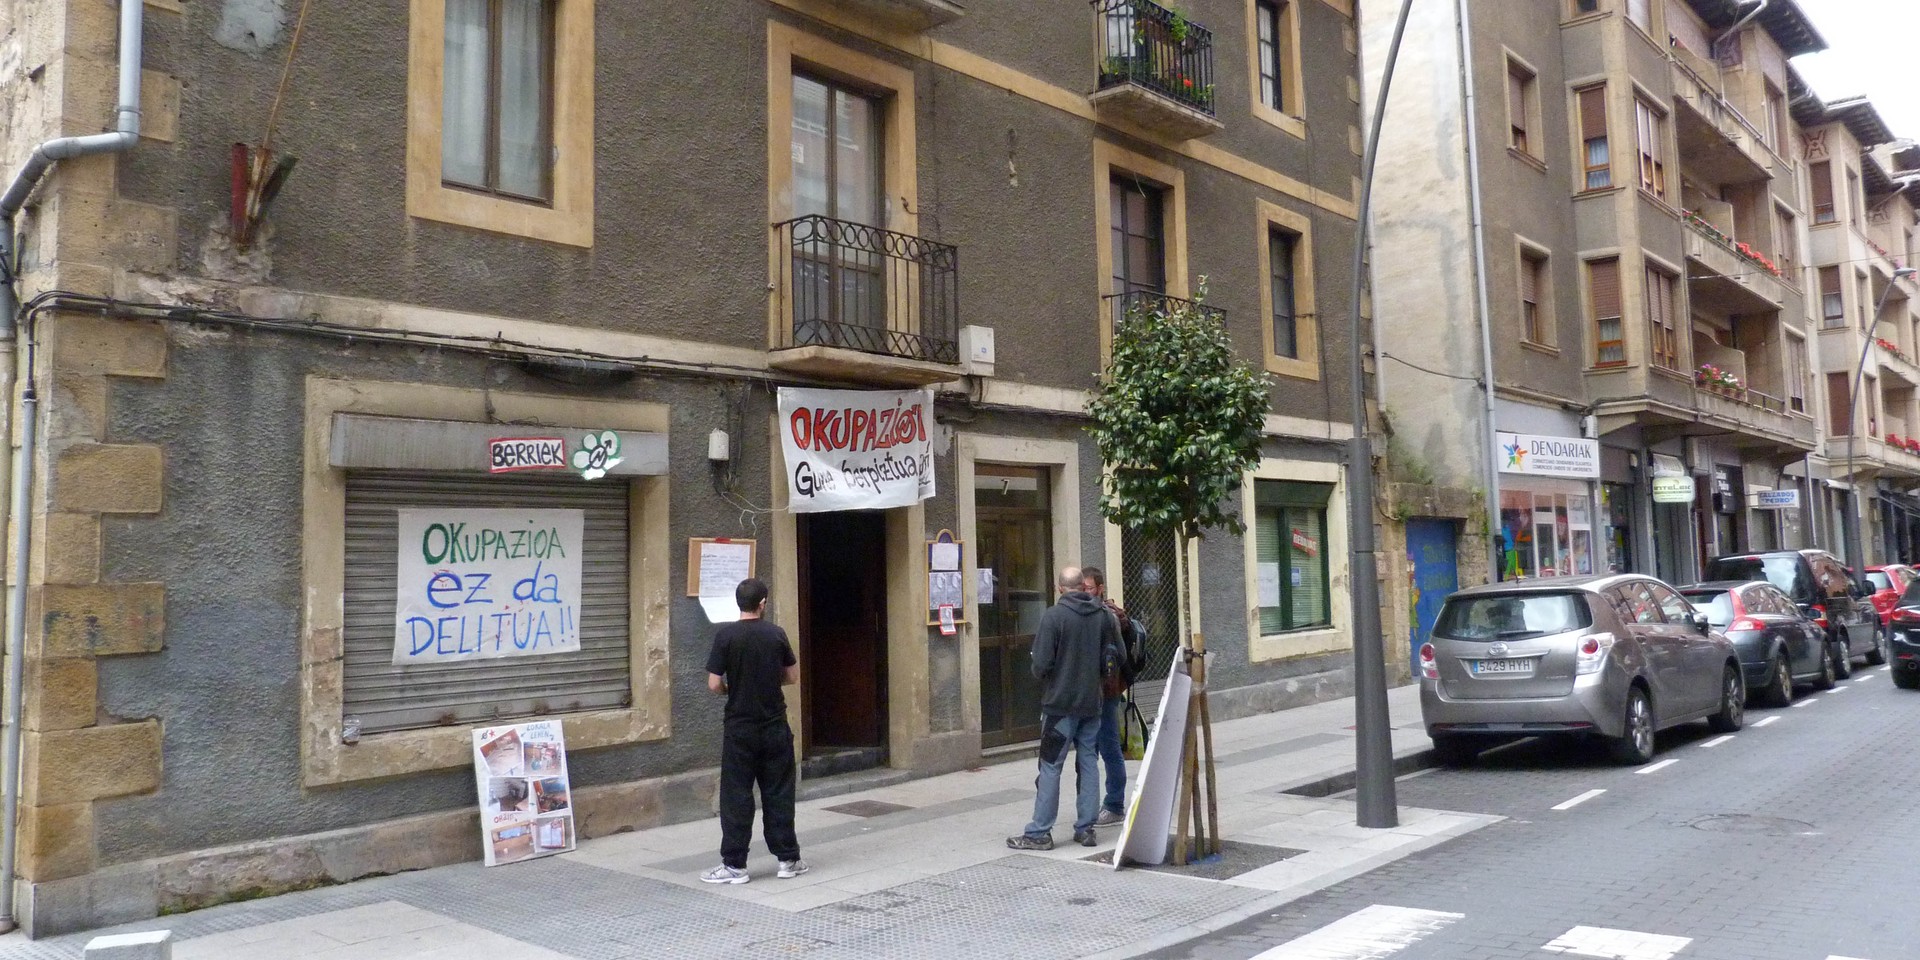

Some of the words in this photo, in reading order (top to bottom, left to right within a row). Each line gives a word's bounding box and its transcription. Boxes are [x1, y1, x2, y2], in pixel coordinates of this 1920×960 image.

[492, 442, 566, 467] BERRIEK
[1531, 440, 1592, 459] DENDARIAK
[841, 452, 919, 494] berpiztua
[1001, 479, 1009, 495] 7
[423, 520, 566, 564] OKUPAZIOA
[427, 572, 493, 609] ez
[513, 561, 562, 603] da
[1480, 661, 1505, 672] 5429
[1509, 660, 1530, 671] HYH
